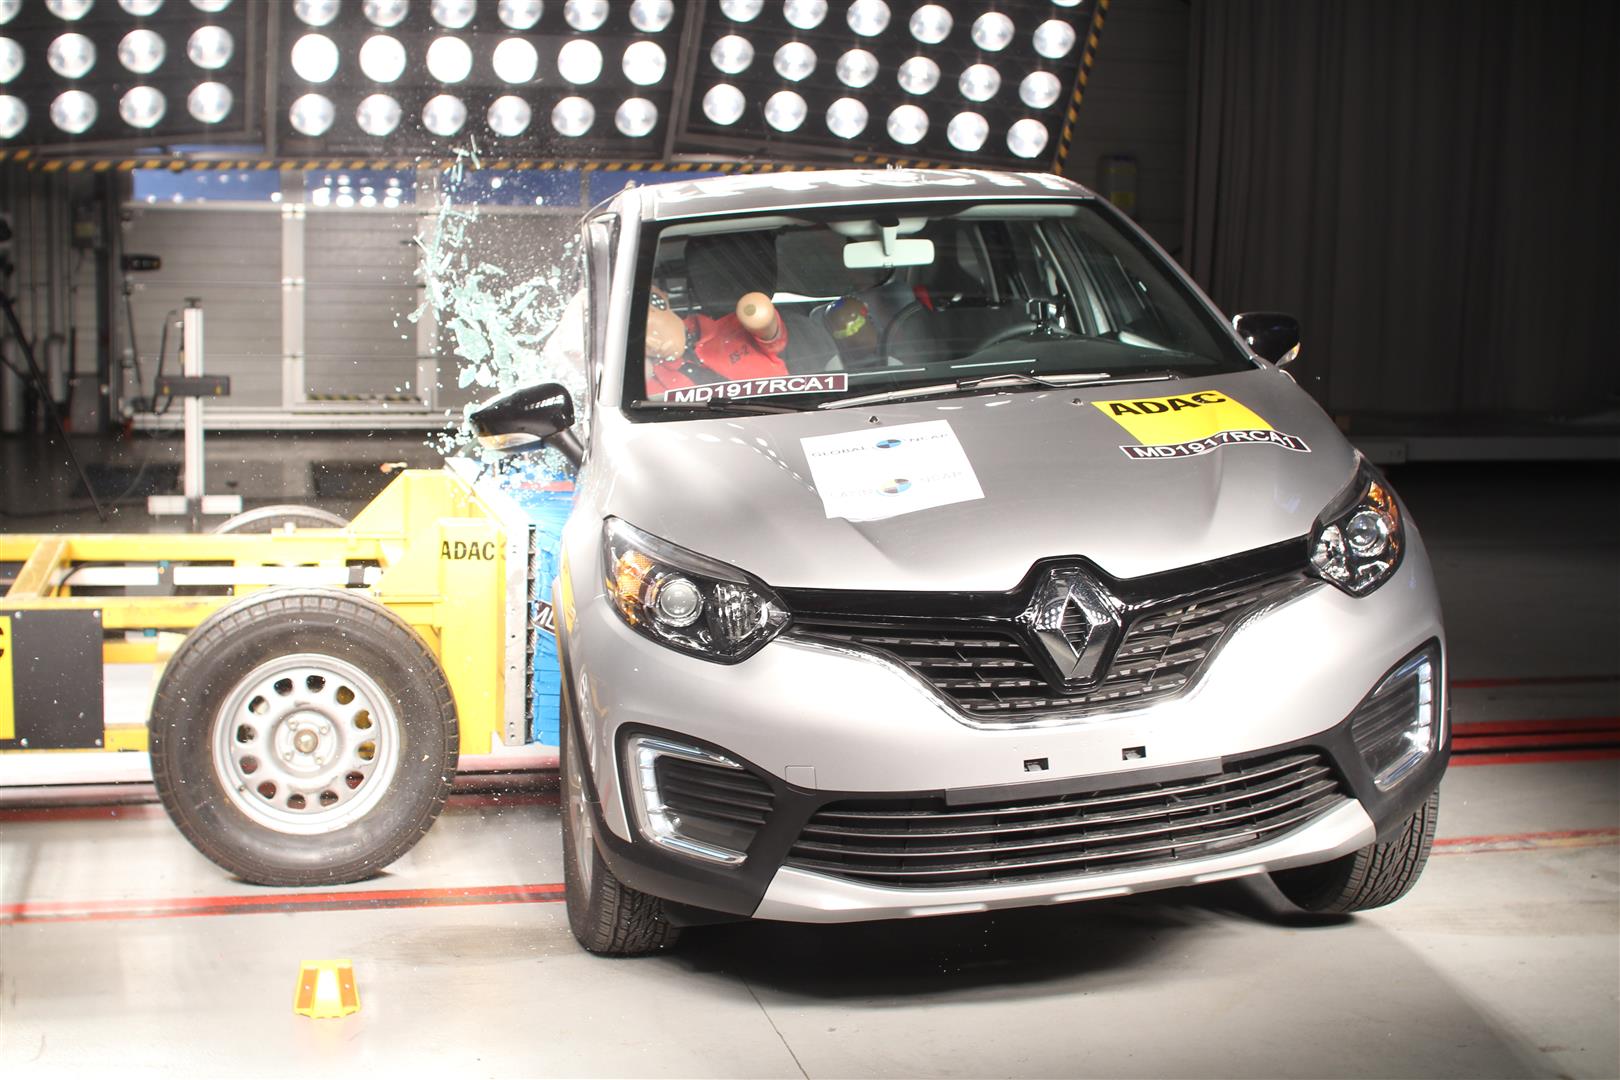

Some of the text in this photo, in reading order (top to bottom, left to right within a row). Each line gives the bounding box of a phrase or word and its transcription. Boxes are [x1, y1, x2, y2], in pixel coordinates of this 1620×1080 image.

[675, 376, 834, 403] MD1917RCA1
[1109, 392, 1227, 416] ADAC
[1132, 431, 1296, 457] MD1917RCA1
[440, 540, 496, 561] ADAC
